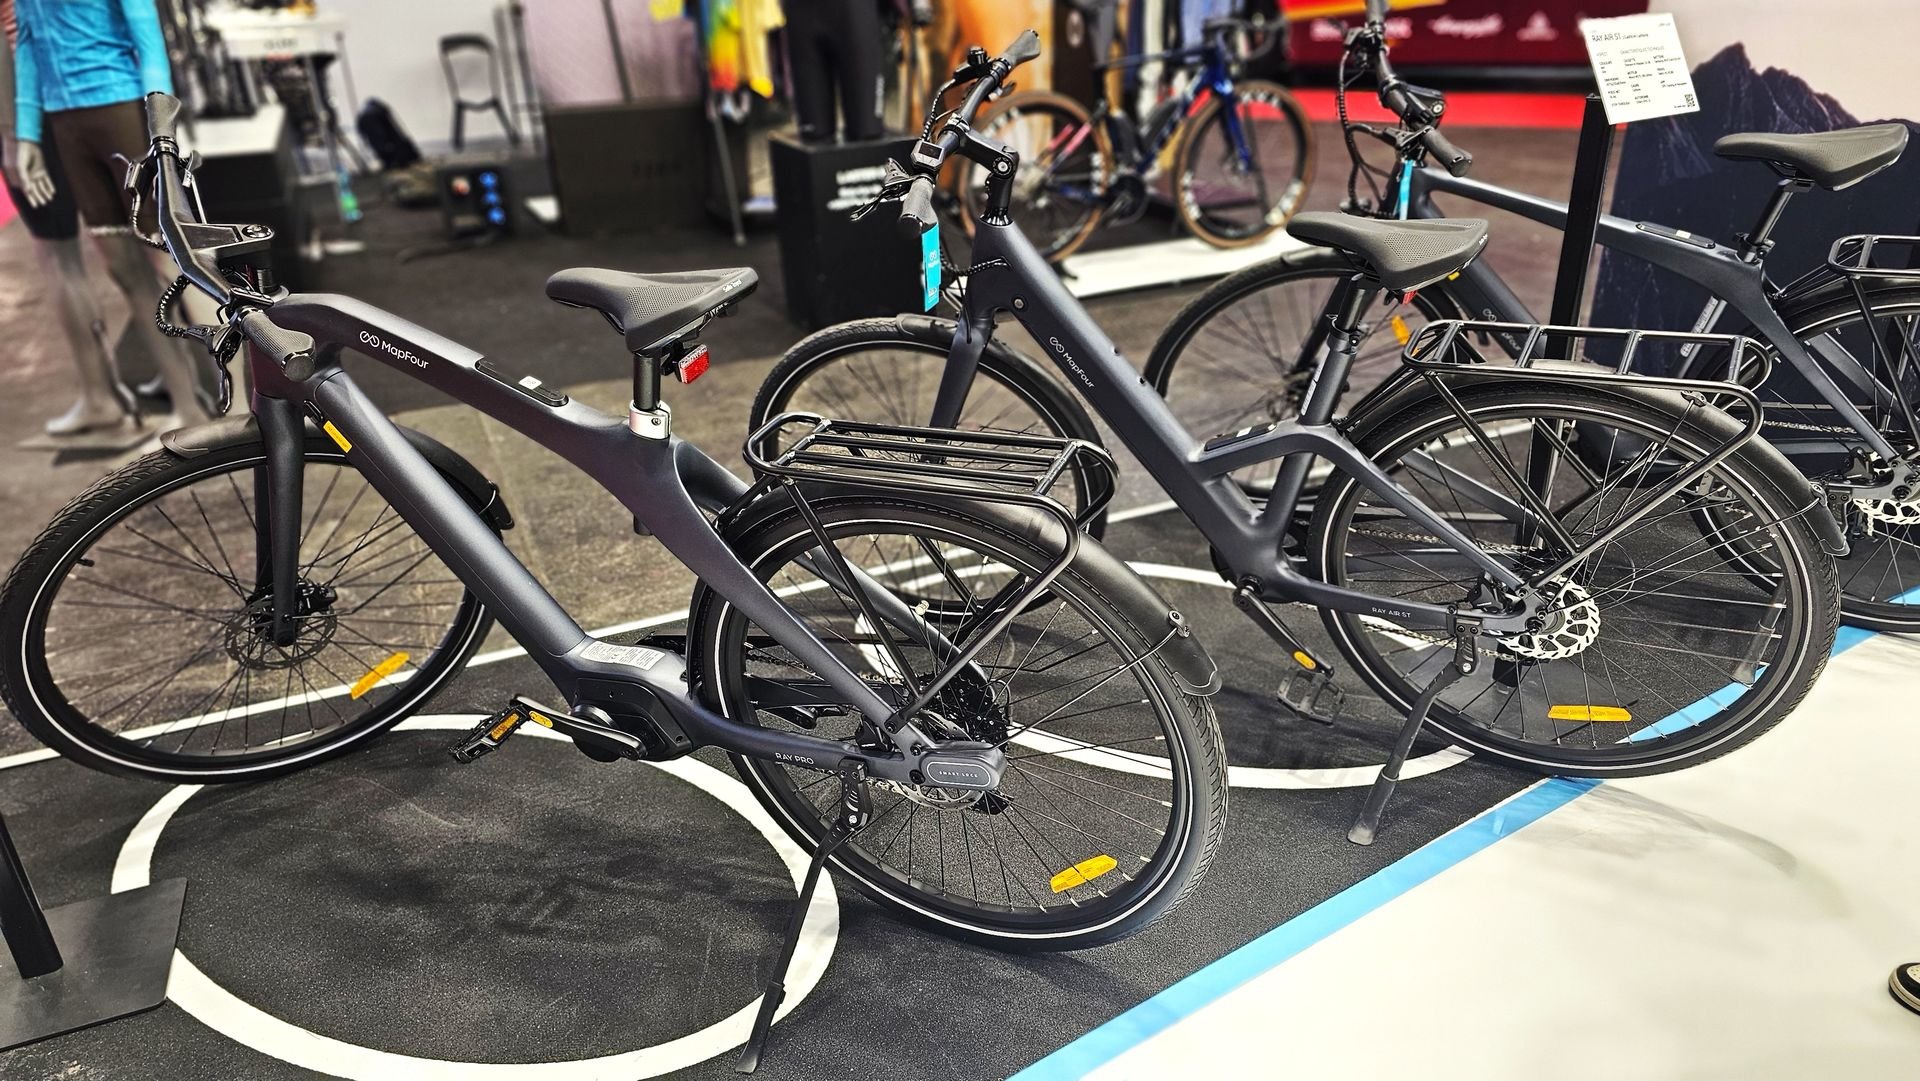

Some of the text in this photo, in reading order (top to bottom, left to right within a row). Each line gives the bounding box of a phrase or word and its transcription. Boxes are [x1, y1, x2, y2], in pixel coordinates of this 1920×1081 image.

[381, 340, 429, 369] MapFour
[1063, 352, 1095, 388] MapFour
[775, 752, 814, 765] RAY PRO
